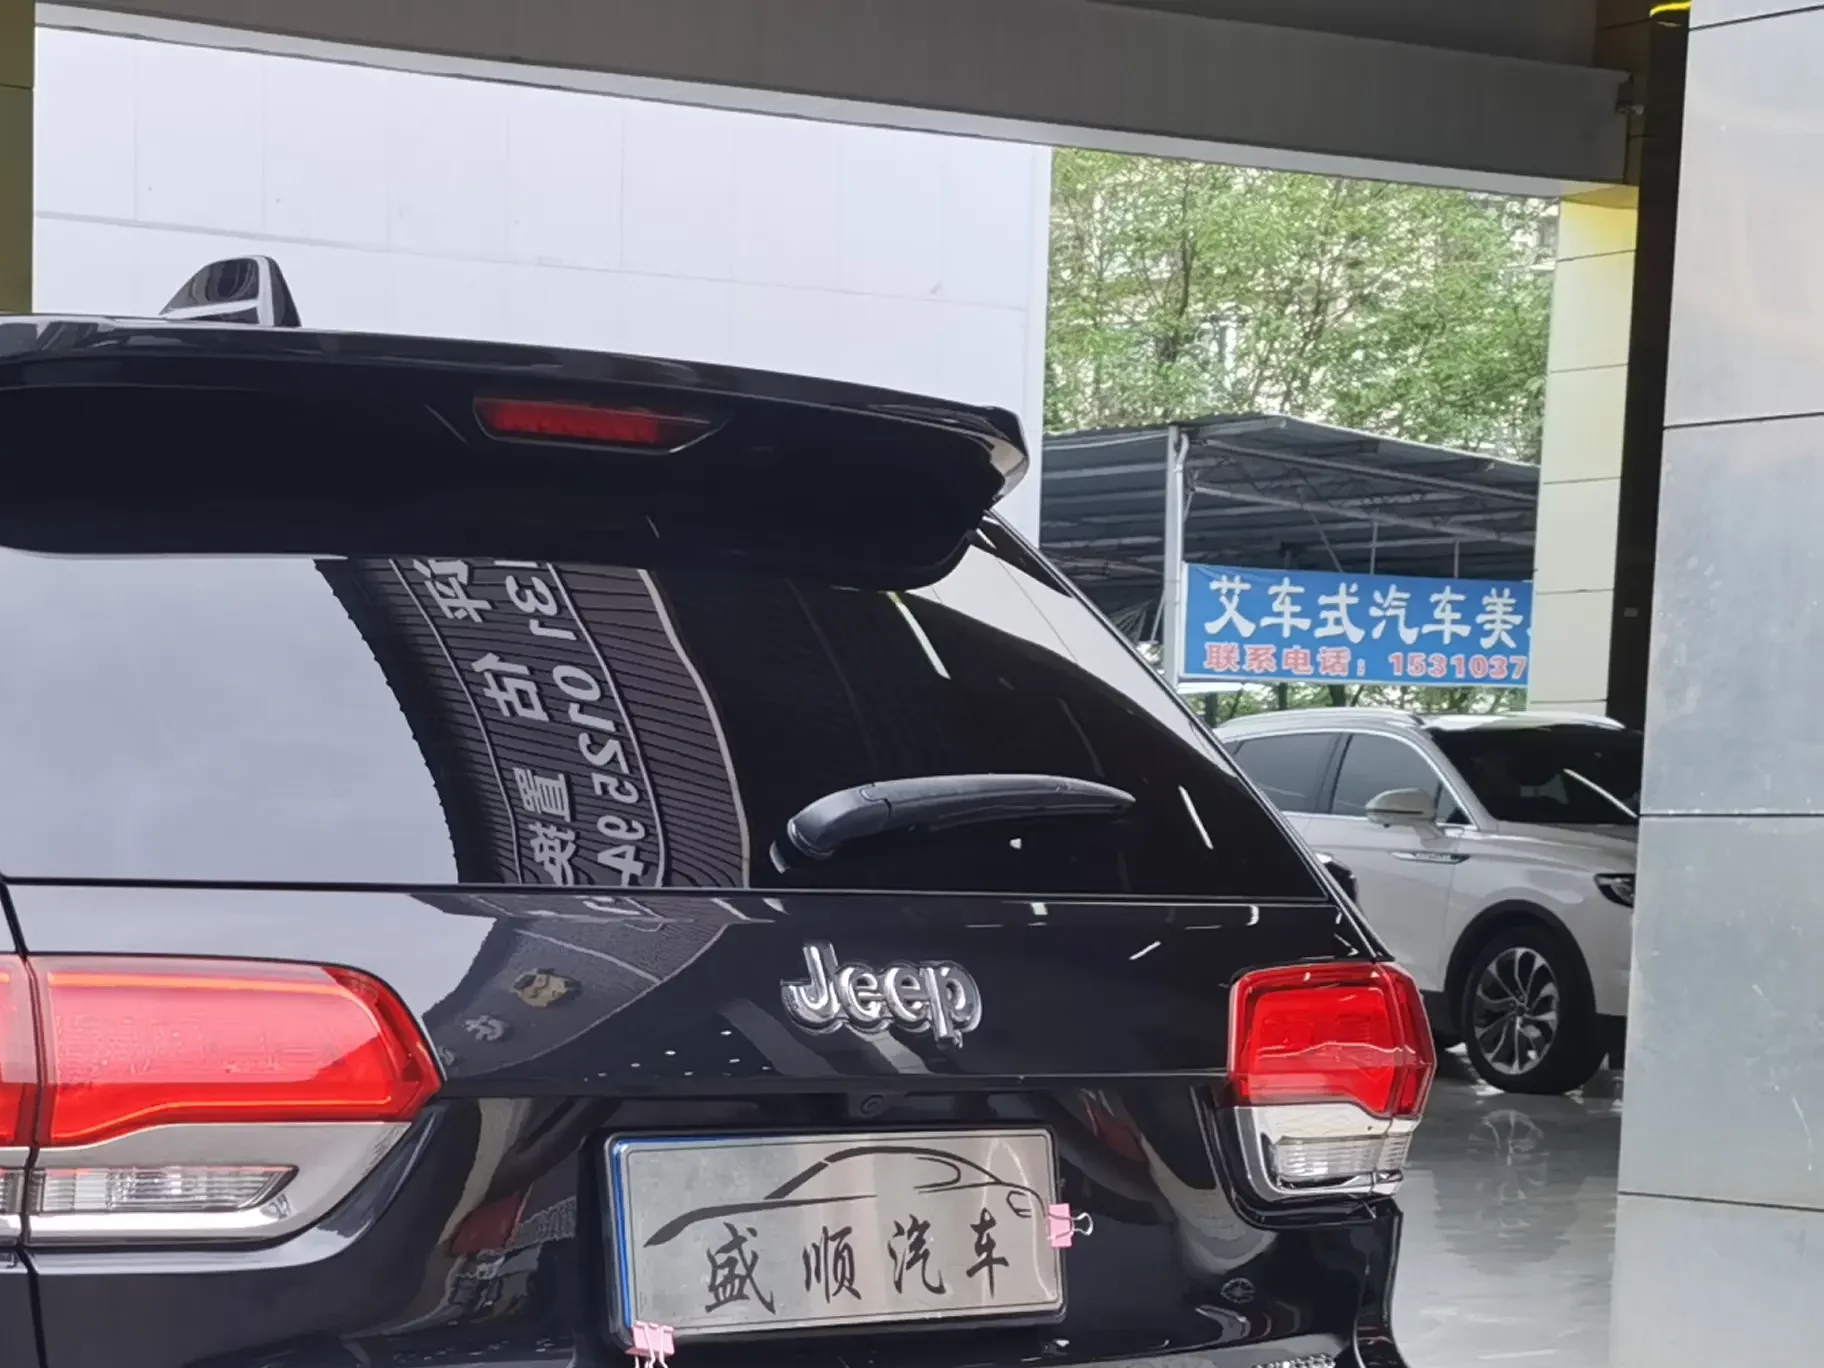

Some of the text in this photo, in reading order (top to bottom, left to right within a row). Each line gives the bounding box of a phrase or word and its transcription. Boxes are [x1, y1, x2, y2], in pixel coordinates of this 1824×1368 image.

[1204, 574, 1532, 650] 艾车式汽车美
[780, 941, 983, 1049] Jeep
[705, 1208, 1010, 1314] 盛顺汽车
